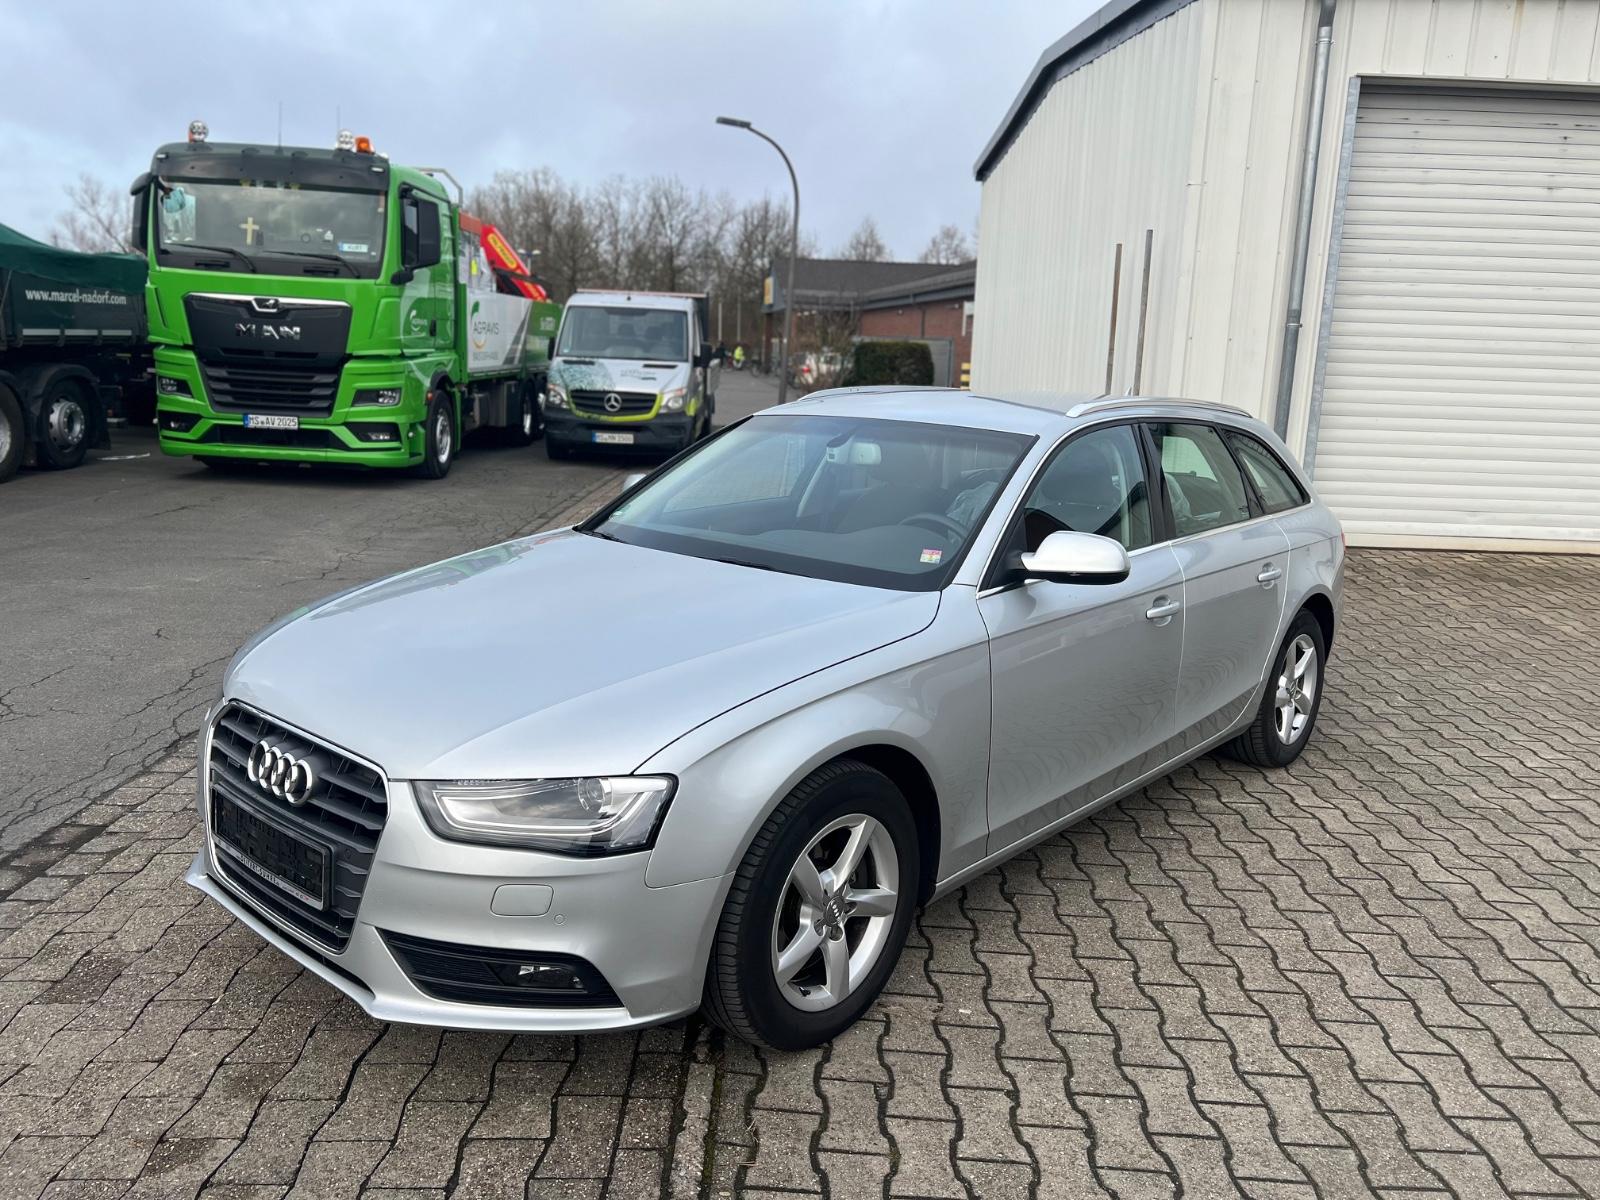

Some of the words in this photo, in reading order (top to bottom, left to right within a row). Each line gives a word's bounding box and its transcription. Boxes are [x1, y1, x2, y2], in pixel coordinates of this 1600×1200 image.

[25, 288, 127, 304] www.marcel-nadorf.com
[235, 323, 300, 340] MAN
[266, 417, 275, 426] AV
